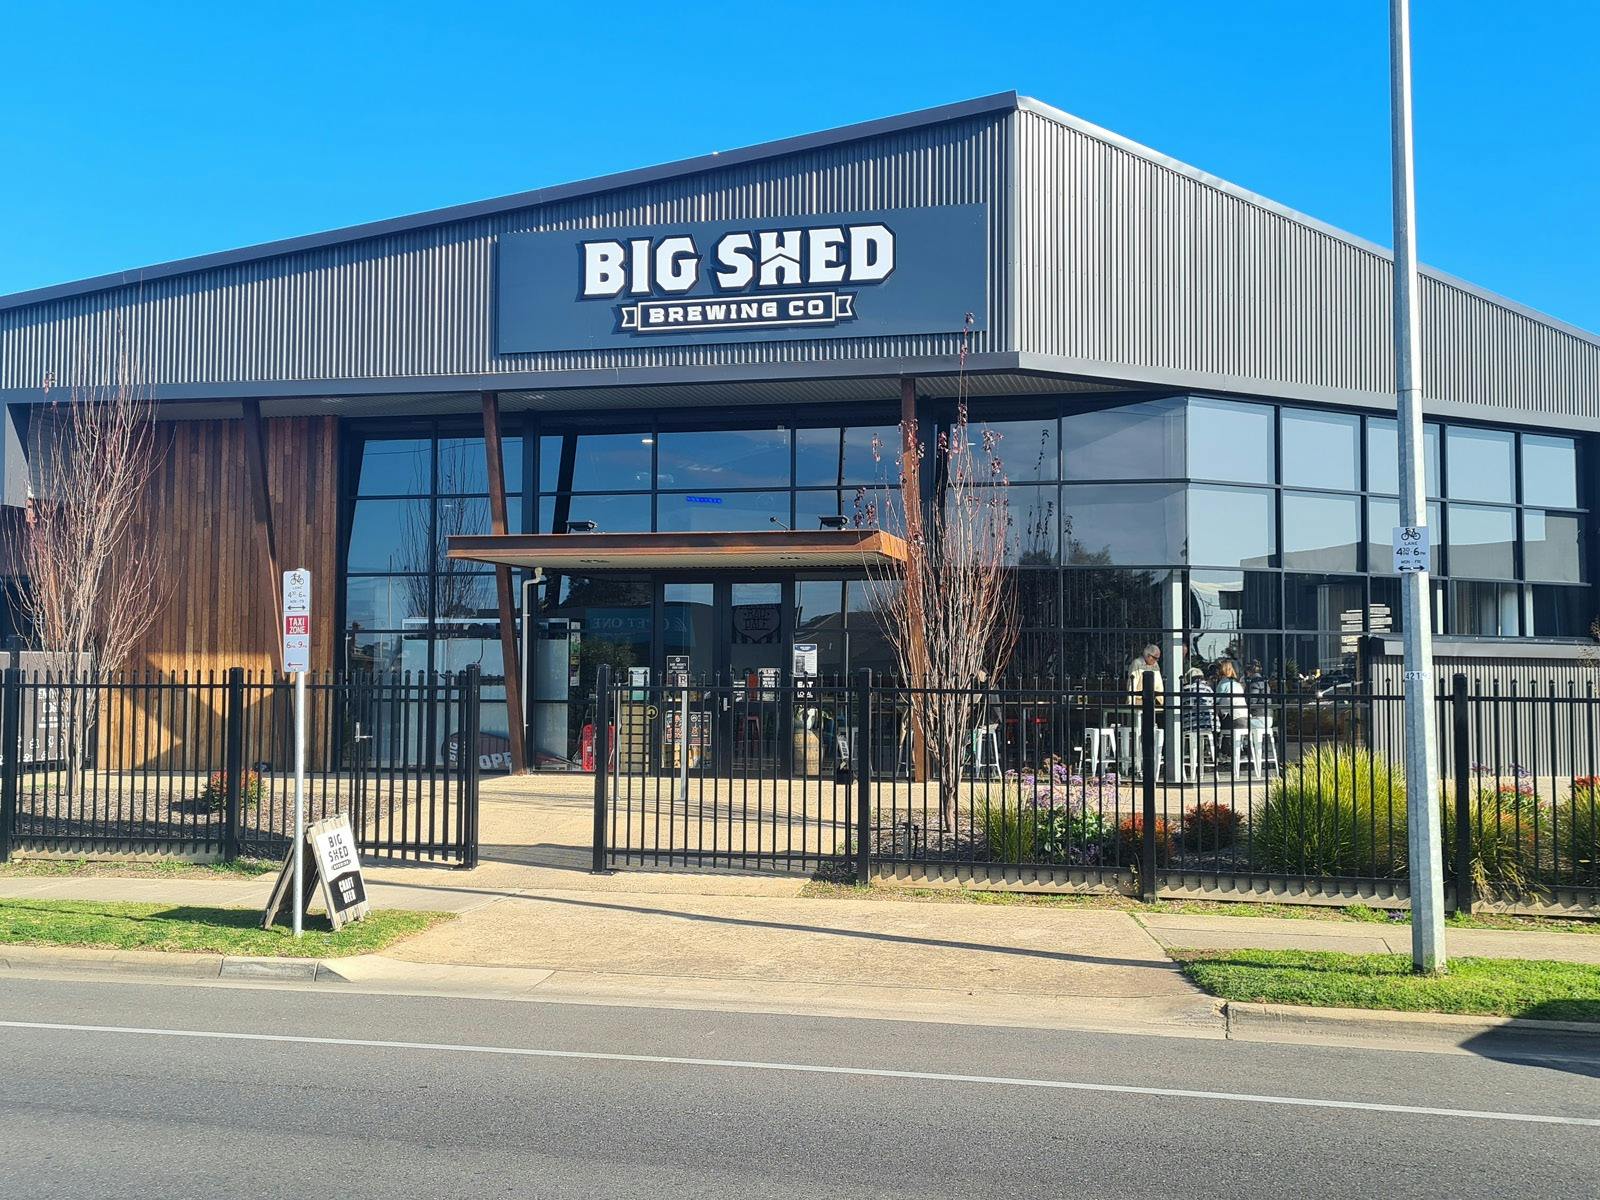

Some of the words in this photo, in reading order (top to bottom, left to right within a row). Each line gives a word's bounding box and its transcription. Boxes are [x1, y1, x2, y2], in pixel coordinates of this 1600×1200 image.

[584, 237, 699, 295] BIG
[716, 225, 894, 288] SHED
[648, 302, 778, 323] BREWING
[788, 299, 824, 316] CO
[288, 617, 305, 626] TAXI
[289, 626, 306, 634] ZONE
[328, 833, 342, 848] BIG
[329, 846, 348, 862] SHED
